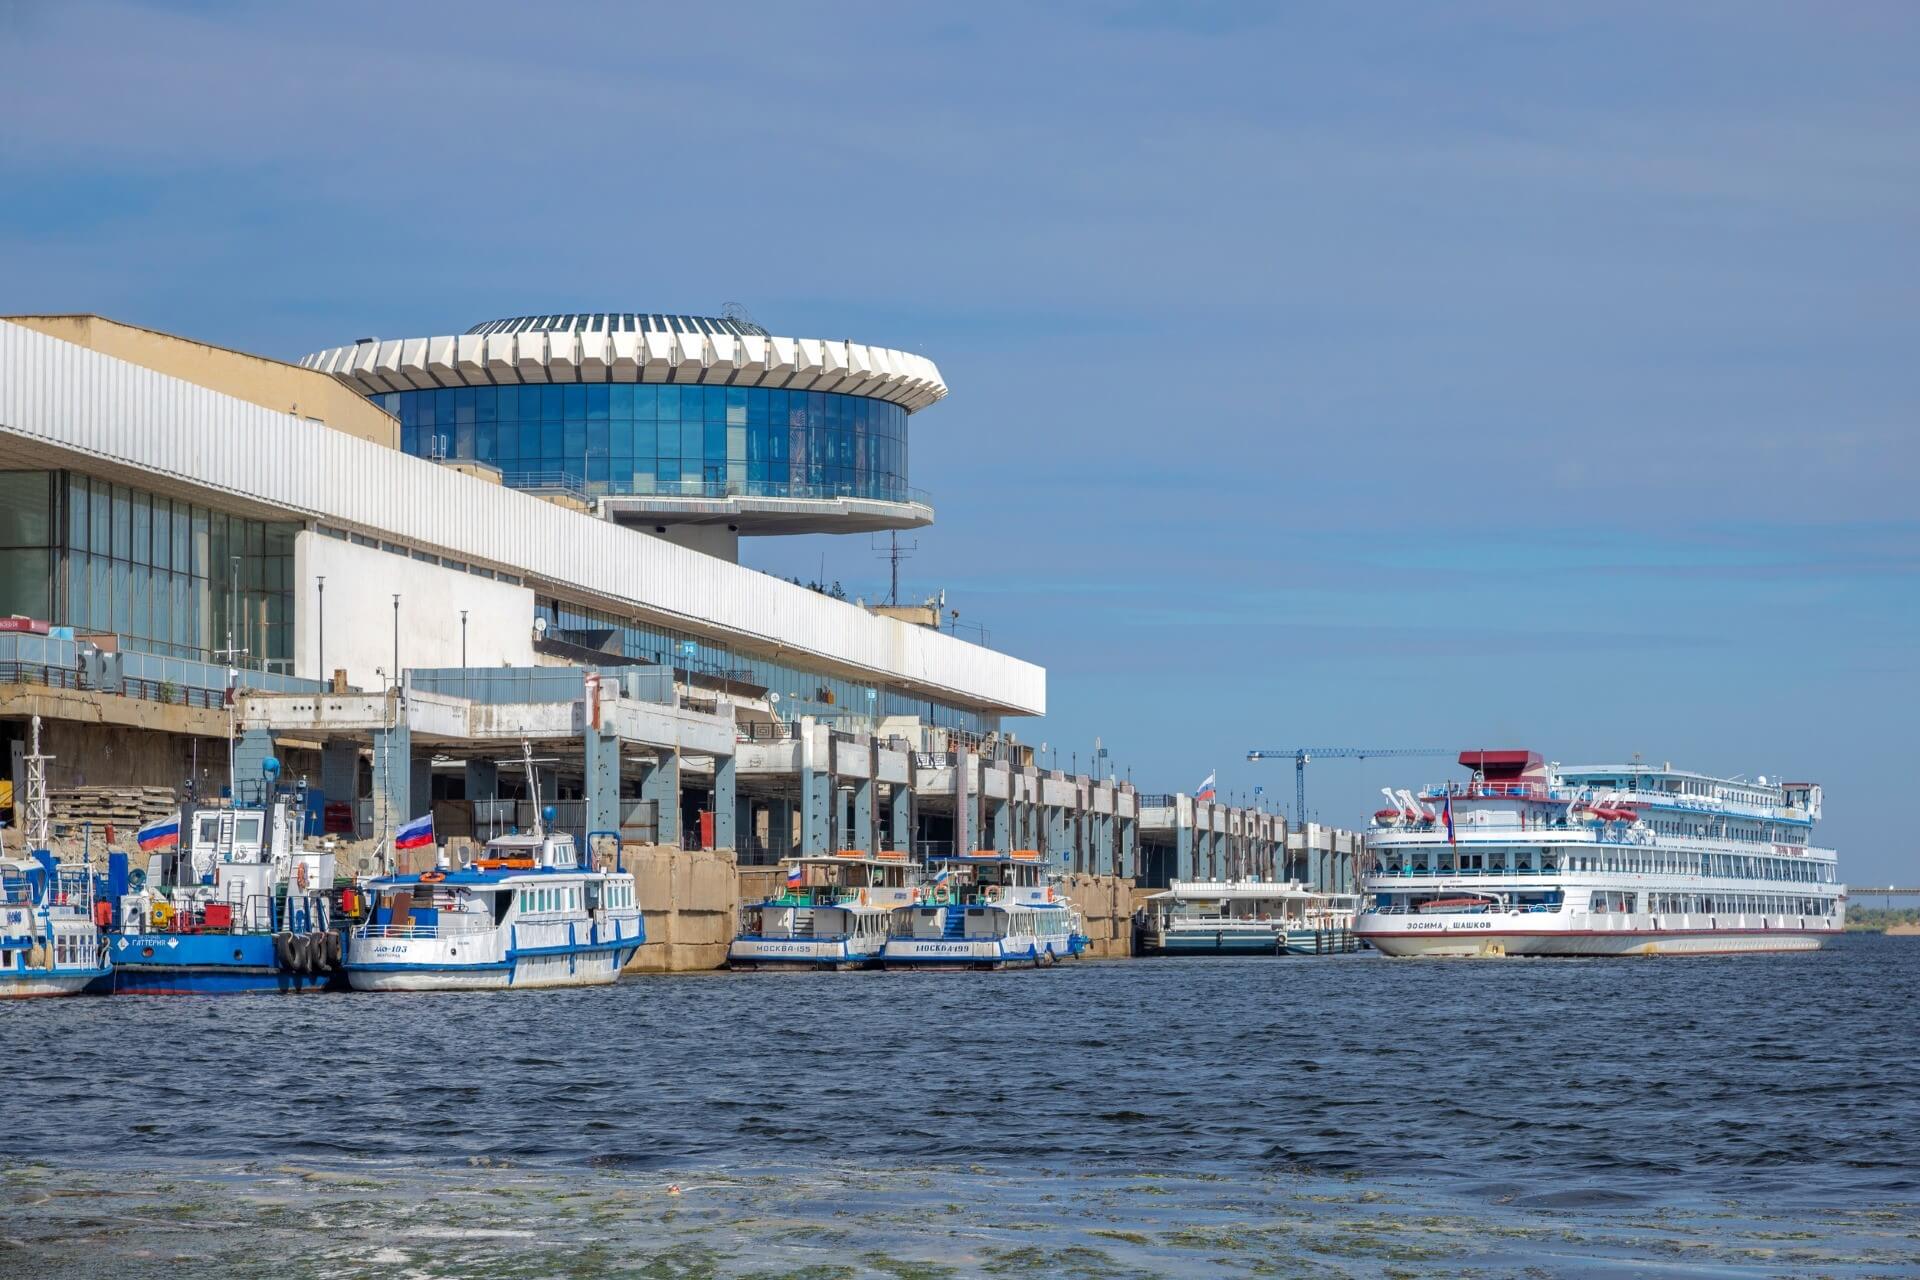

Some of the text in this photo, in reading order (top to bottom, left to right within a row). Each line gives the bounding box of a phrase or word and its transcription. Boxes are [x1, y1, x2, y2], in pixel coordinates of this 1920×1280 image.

[1407, 921, 1492, 930] ЗОСИМА ШАШКОВ
[756, 945, 811, 953] МОСКВА-155
